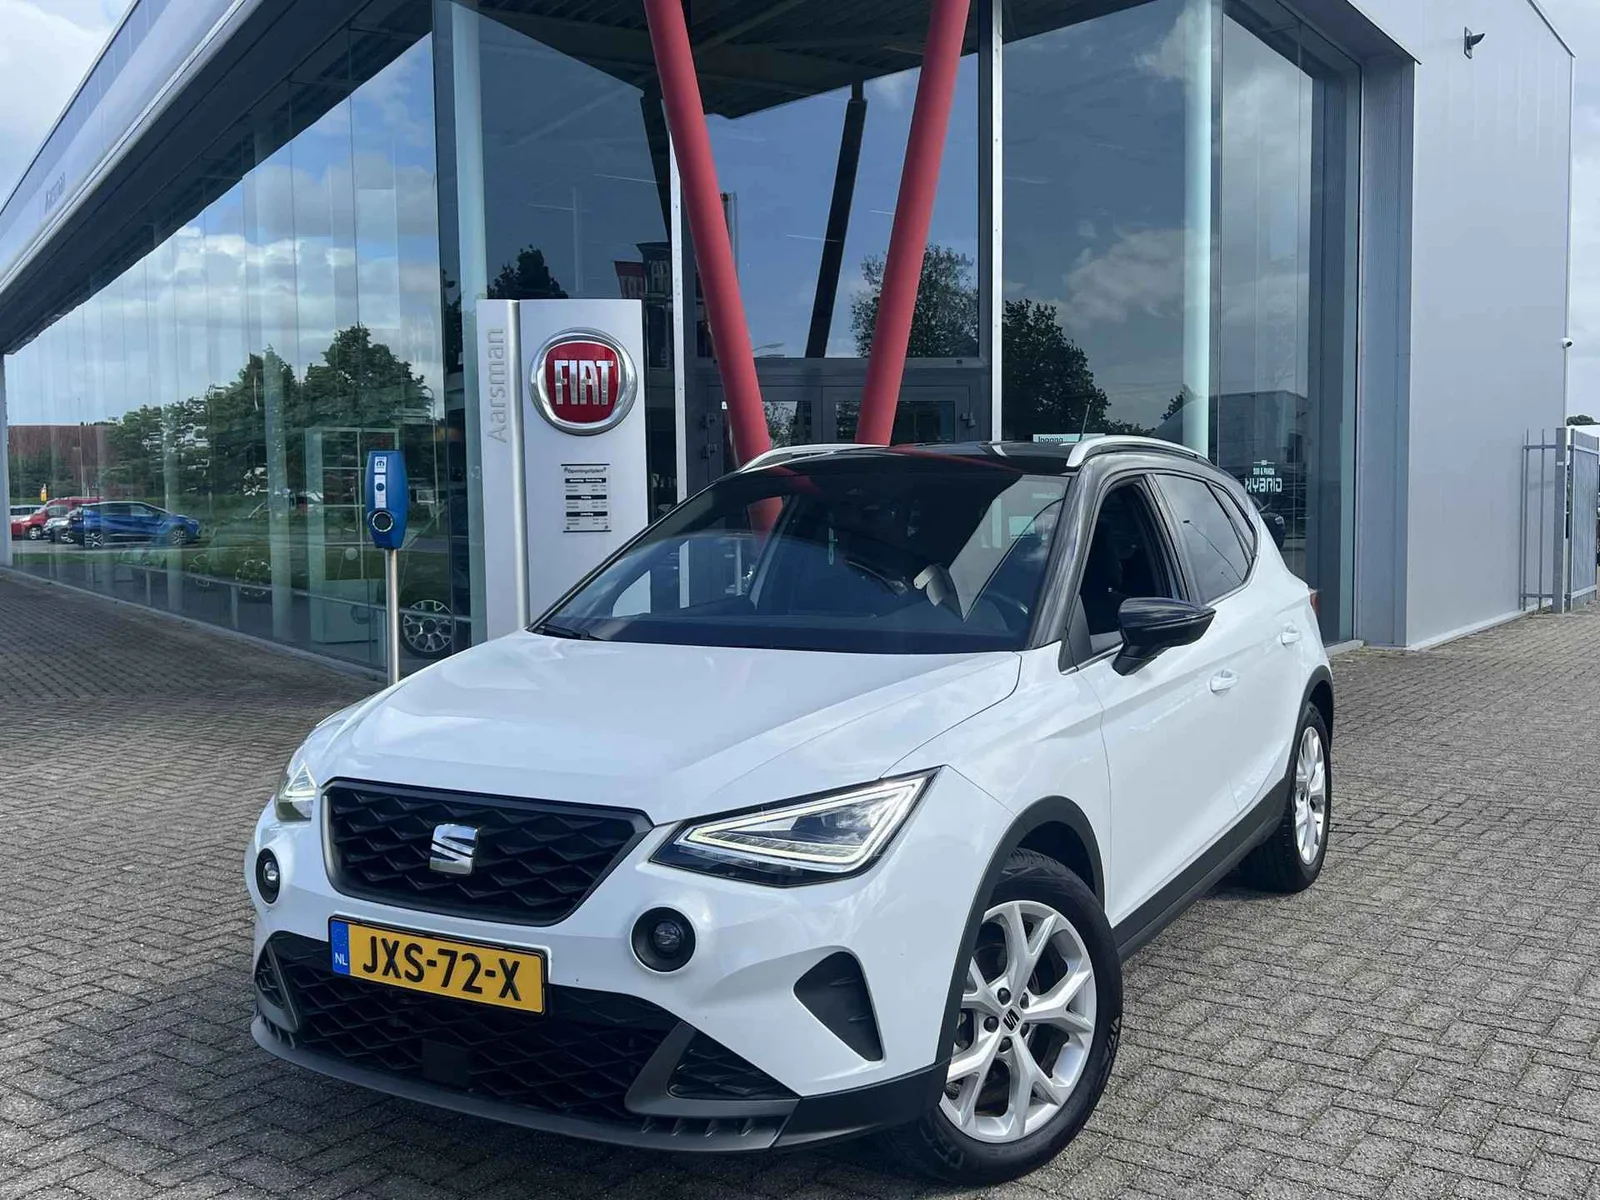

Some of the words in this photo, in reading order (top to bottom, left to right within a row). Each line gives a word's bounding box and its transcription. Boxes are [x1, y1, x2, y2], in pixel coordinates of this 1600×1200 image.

[488, 328, 507, 443] Aarsman
[554, 360, 613, 405] FIAT
[1245, 477, 1282, 492] HYBRID
[334, 953, 348, 966] NL
[363, 936, 521, 1001] JXS-72-X
